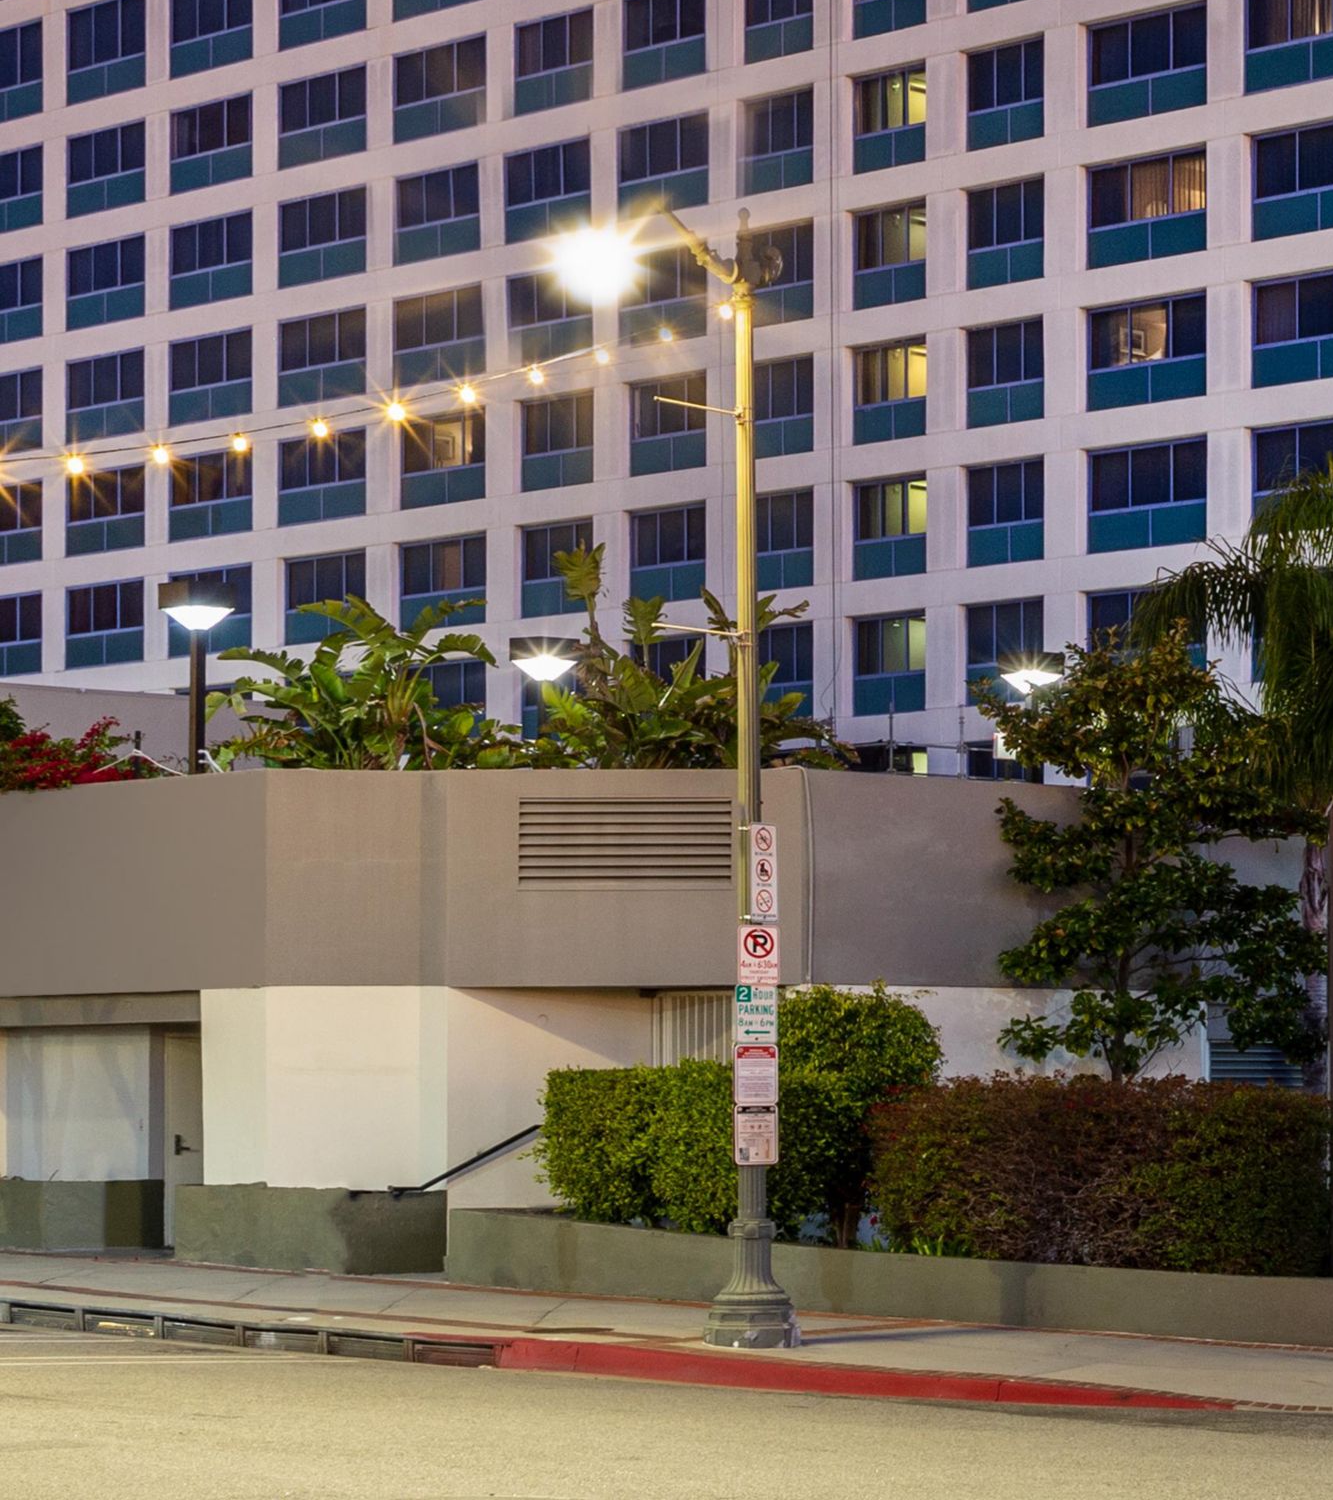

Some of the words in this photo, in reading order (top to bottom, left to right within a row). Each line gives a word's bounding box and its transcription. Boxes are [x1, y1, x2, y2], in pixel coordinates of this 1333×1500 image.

[738, 986, 749, 1000] 2
[753, 990, 774, 1000] HOUR
[738, 1003, 775, 1016] PARKING
